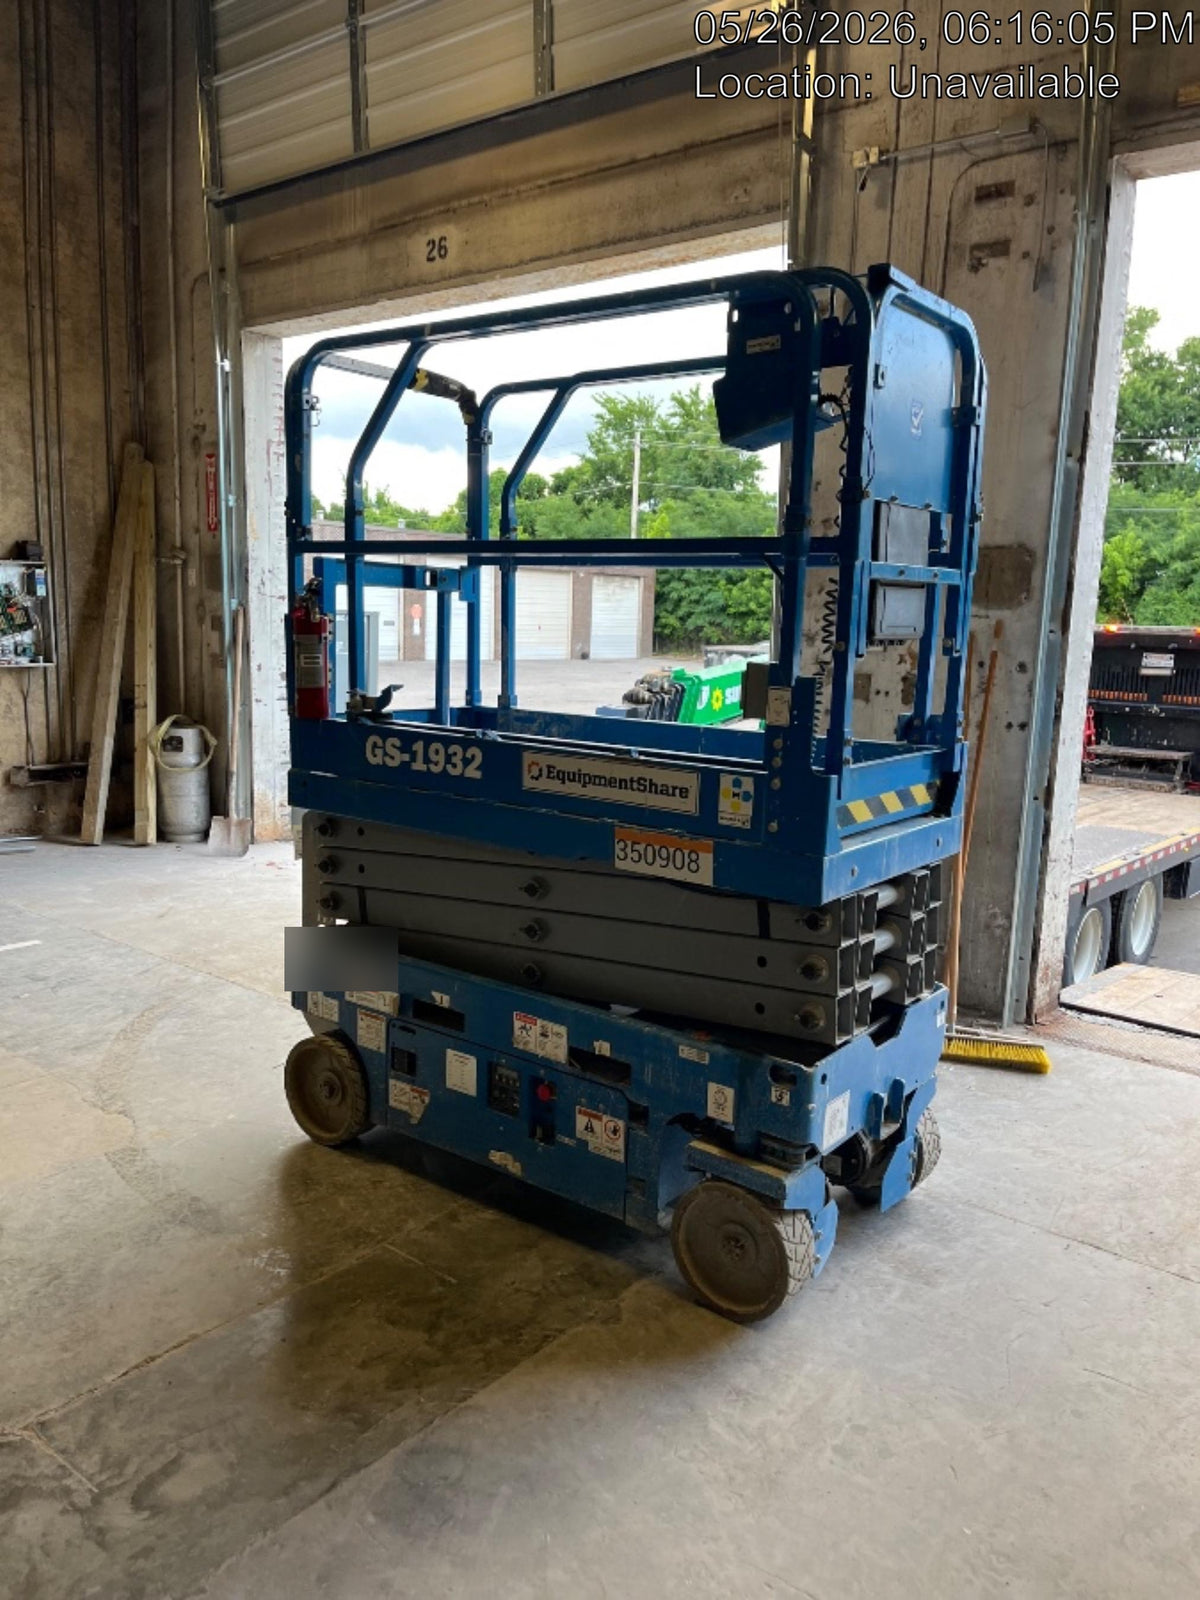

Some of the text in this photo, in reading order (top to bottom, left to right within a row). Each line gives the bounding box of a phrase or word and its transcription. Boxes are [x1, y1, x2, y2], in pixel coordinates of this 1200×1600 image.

[426, 235, 449, 263] 26
[365, 734, 483, 780] GS-1932
[545, 764, 690, 799] EquipmentShare
[616, 838, 700, 874] 350908
